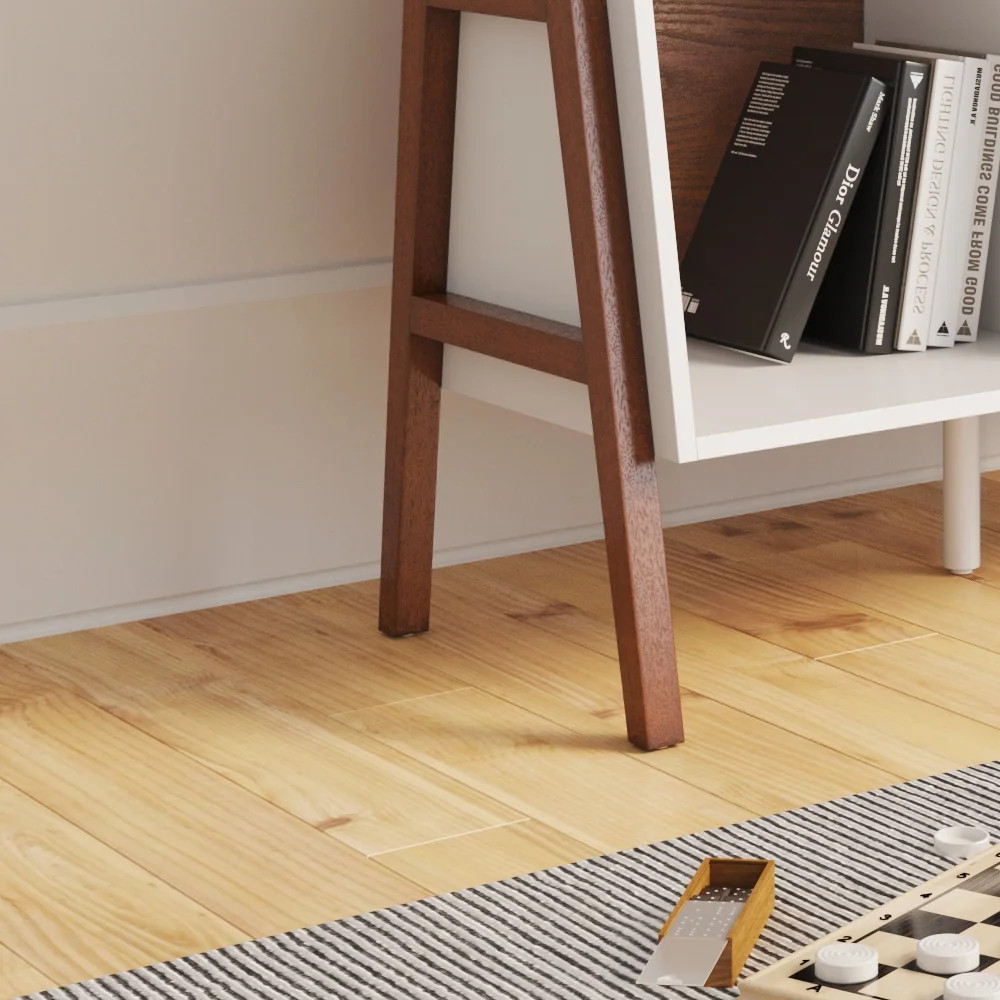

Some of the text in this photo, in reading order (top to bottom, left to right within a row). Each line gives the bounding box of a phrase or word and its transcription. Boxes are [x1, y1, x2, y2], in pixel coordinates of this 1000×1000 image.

[866, 91, 886, 133] Mark Shaw
[806, 163, 861, 282] Dior Glamour
[806, 984, 822, 993] A
